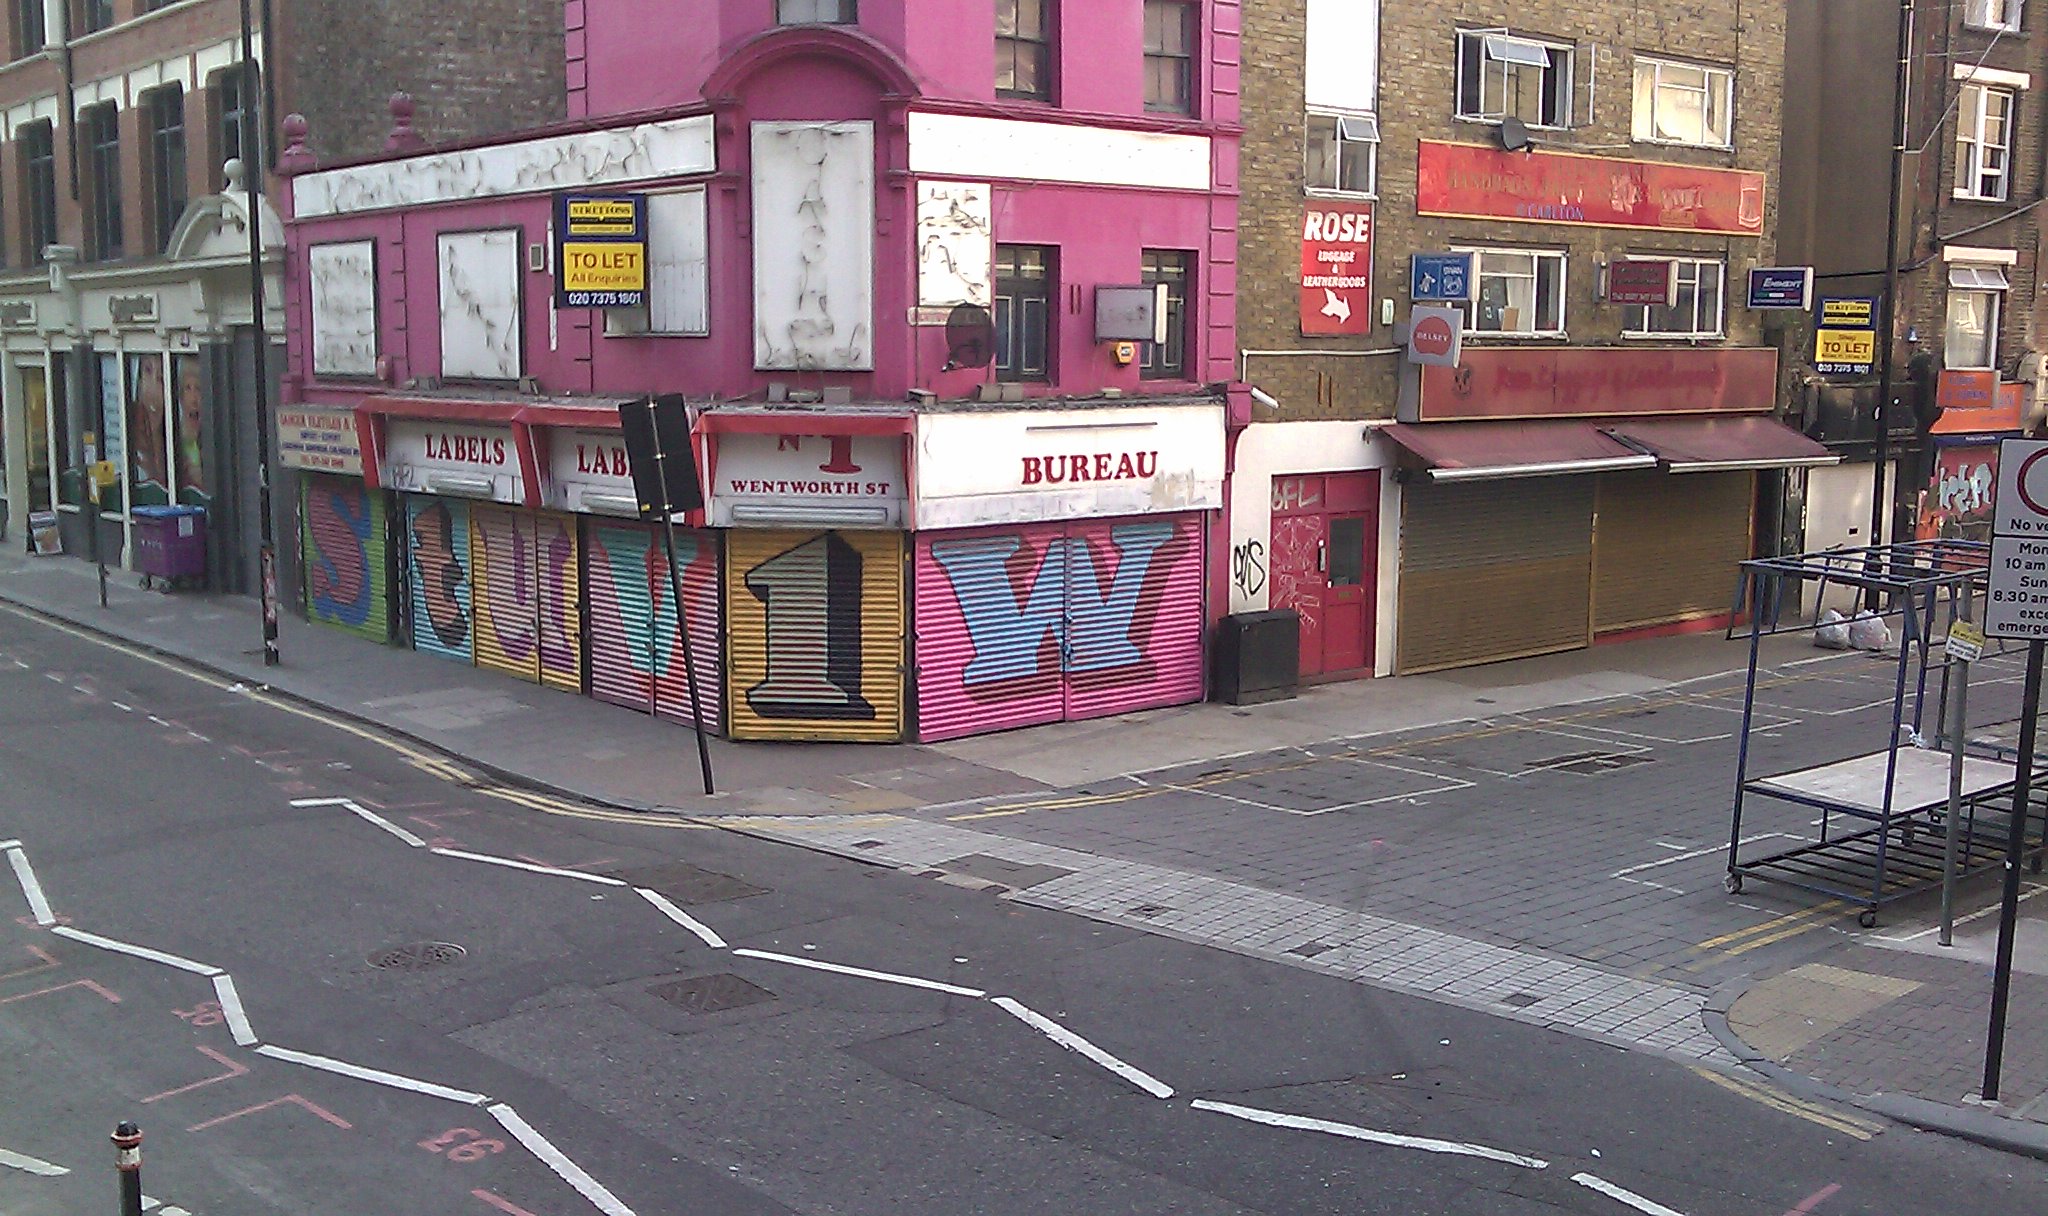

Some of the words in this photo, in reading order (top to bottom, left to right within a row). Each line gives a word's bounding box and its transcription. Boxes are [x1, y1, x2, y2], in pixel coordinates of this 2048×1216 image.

[1303, 211, 1370, 243] ROSE
[570, 252, 597, 269] TO
[602, 252, 638, 269] LET
[571, 273, 587, 282] All
[588, 273, 638, 285] Enquiries
[568, 293, 589, 304] 020
[591, 293, 616, 304] 7375
[1824, 342, 1841, 353] TO
[1846, 342, 1871, 354] LET
[424, 434, 506, 465] LABELS
[1021, 450, 1158, 485] BUREAU
[731, 480, 859, 495] WENTWORTH
[865, 482, 890, 495] ST
[2010, 519, 2031, 531] No
[2005, 558, 2021, 569] 10
[2025, 561, 2046, 571] am
[1993, 590, 2028, 603] 8.30
